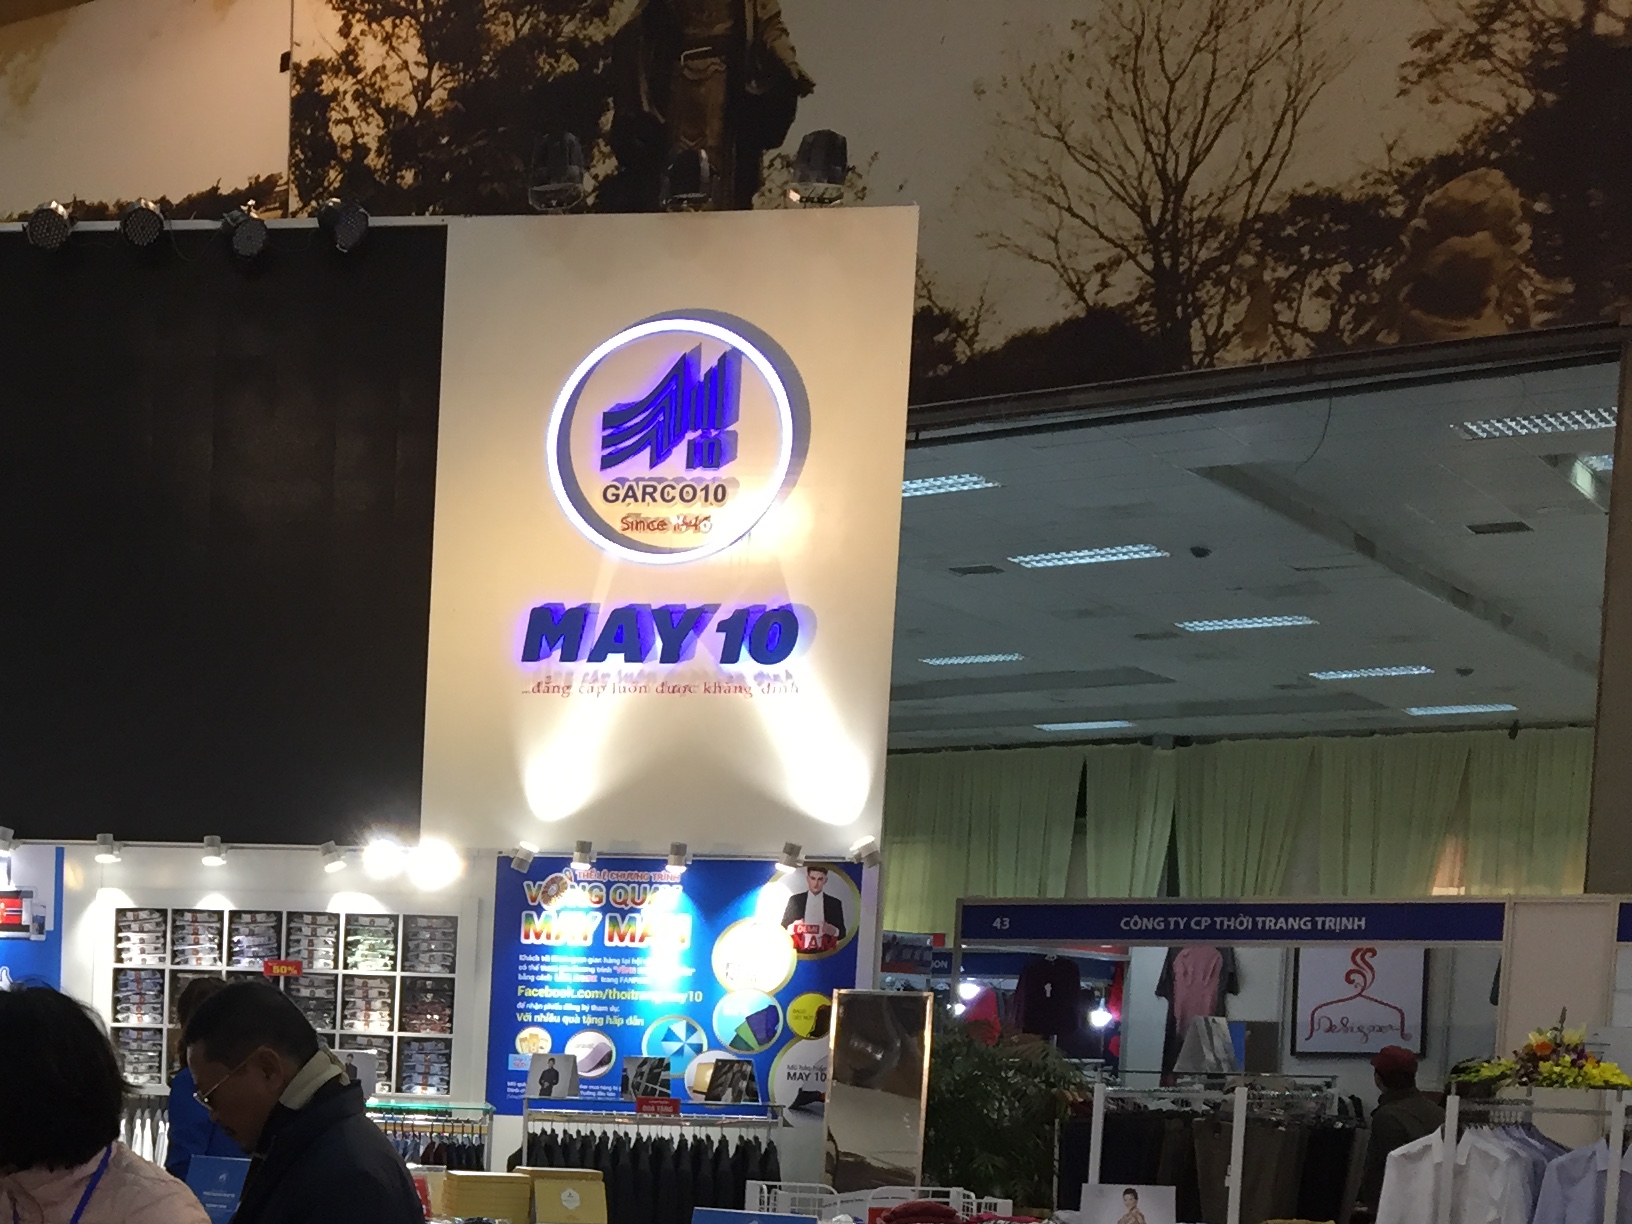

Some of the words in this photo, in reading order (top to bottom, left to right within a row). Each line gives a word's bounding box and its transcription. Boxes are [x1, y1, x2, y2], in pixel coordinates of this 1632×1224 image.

[602, 483, 727, 503] GARCO10
[620, 514, 667, 532] Since
[521, 606, 710, 664] MAY
[715, 607, 799, 665] 10
[655, 679, 696, 697] được
[992, 917, 1010, 930] 43
[1119, 914, 1165, 931] CÔNG
[1168, 916, 1188, 931] TY
[1190, 916, 1212, 931] CP
[1214, 913, 1253, 931] THỜI
[1256, 916, 1312, 931] TRANG
[1316, 916, 1366, 933] TRỊNH
[272, 965, 298, 975] 50%
[516, 1011, 532, 1022] Với
[533, 1011, 561, 1023] nhiều
[561, 1013, 581, 1026] quà
[581, 1014, 604, 1026] tặng
[605, 1014, 624, 1027] hấp
[625, 1014, 645, 1026] dẫn
[786, 1071, 811, 1081] MAY
[814, 1072, 828, 1082] 10
